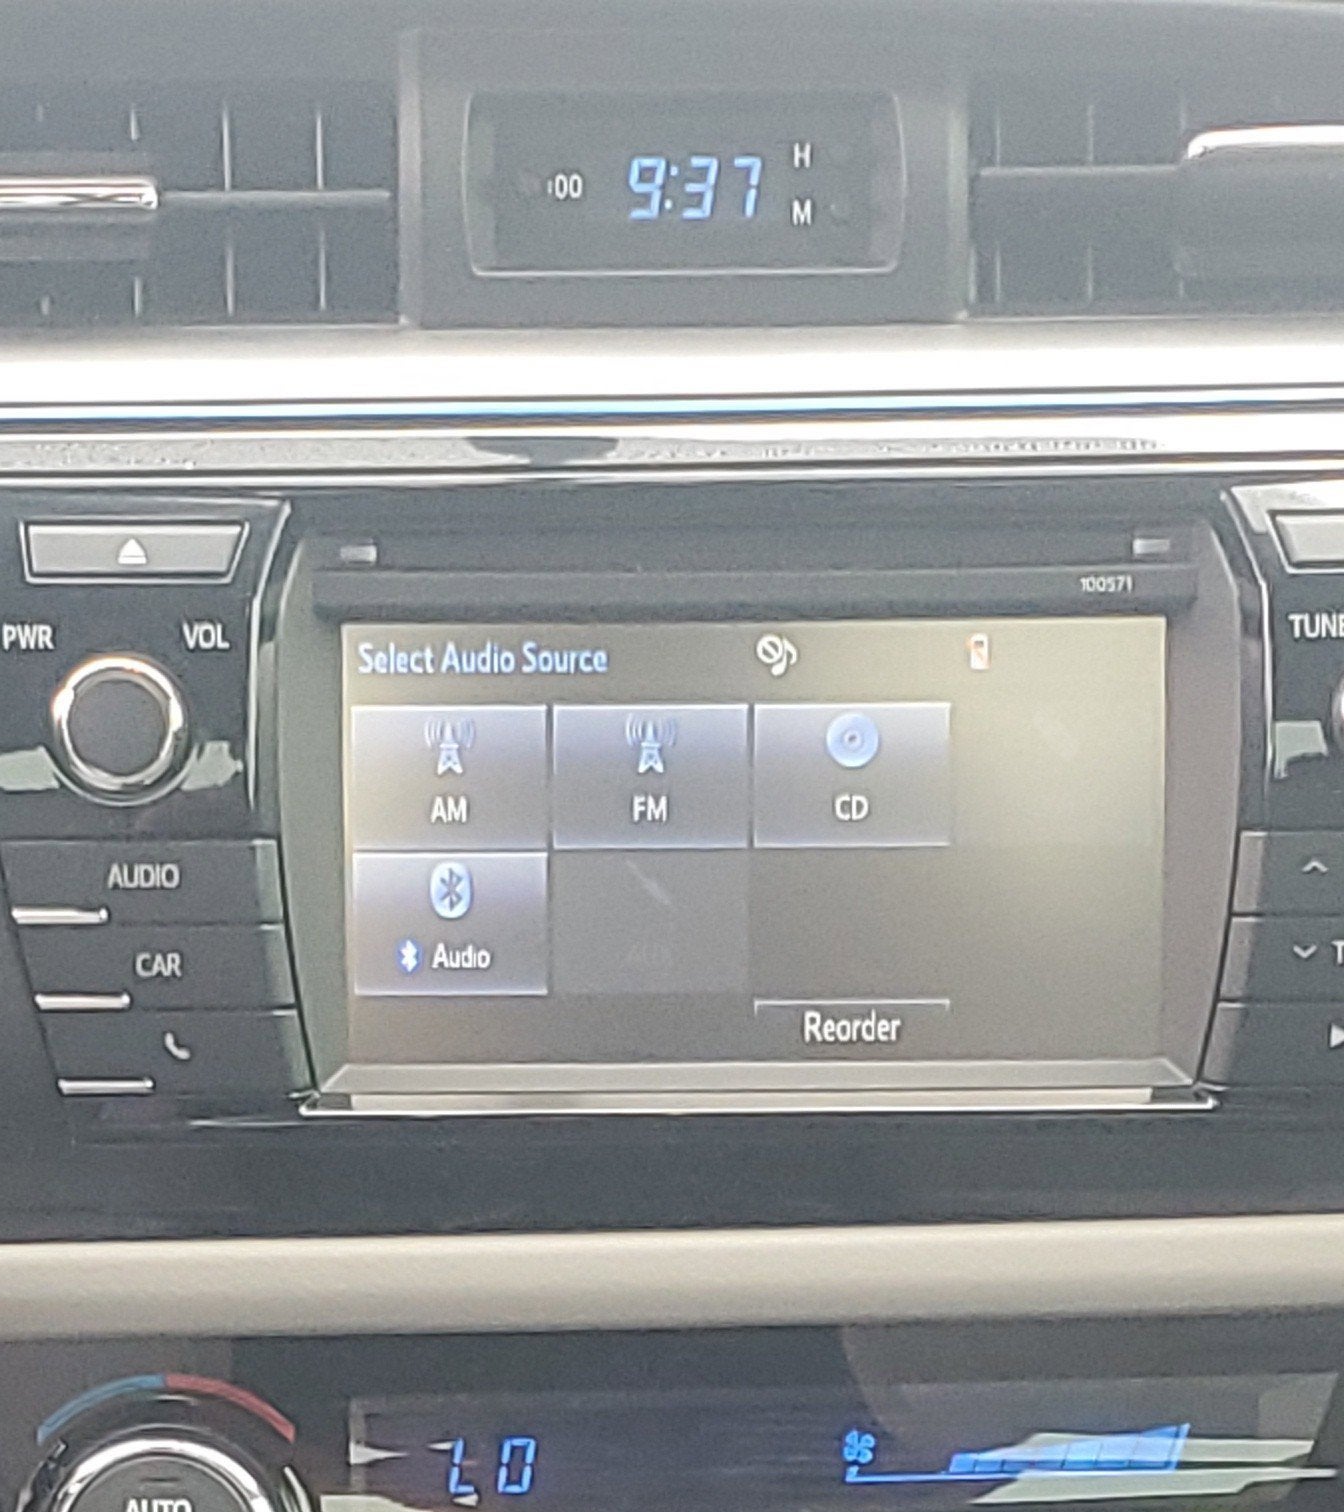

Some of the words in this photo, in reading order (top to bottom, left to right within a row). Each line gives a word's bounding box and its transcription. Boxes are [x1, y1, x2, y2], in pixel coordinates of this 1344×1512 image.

[793, 142, 811, 168] H
[628, 156, 762, 220] 9:37
[792, 199, 812, 225] M
[1080, 575, 1132, 592] 100571
[2, 623, 54, 650] PWR
[182, 622, 230, 649] VOL
[357, 641, 434, 674] Select
[440, 641, 515, 674] Audio
[521, 641, 608, 674] Source
[430, 796, 467, 823] AM
[633, 795, 667, 822] FM
[835, 793, 869, 821] CD
[107, 863, 180, 888] AUDIO
[135, 952, 182, 977] CAR
[431, 942, 491, 969] Audio
[804, 1009, 901, 1042] Reorder
